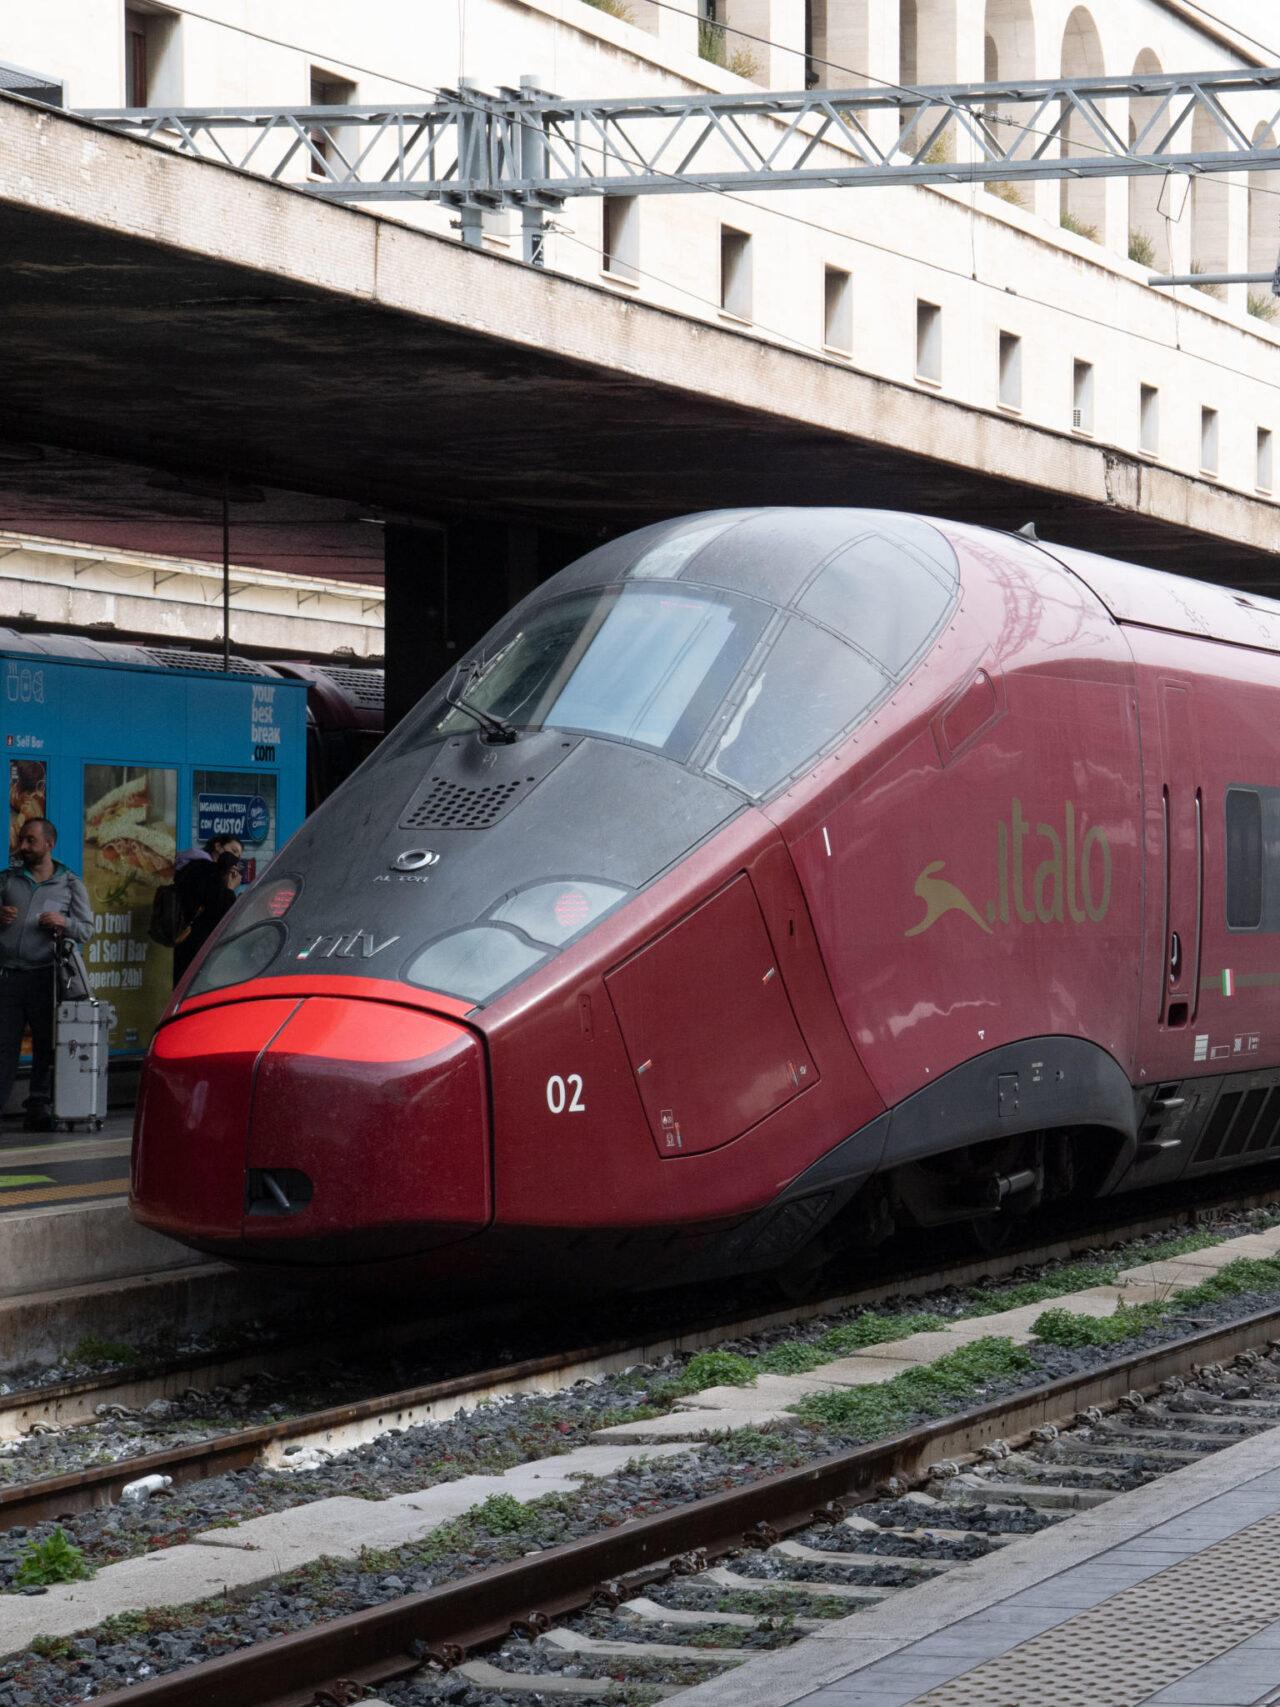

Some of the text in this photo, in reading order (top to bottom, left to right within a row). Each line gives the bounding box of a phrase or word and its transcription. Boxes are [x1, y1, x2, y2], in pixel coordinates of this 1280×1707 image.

[252, 685, 275, 703] your
[252, 703, 273, 723] best
[16, 735, 44, 749] Self Bar
[252, 723, 281, 744] break
[251, 745, 276, 762] .com
[199, 802, 223, 812] INGANNA
[213, 815, 246, 834] GUSTO!
[372, 874, 430, 883] ALTOM
[105, 910, 132, 934] trovi
[89, 938, 148, 963] al Self Bar
[88, 970, 121, 990] aperto
[546, 1073, 586, 1114] 02
